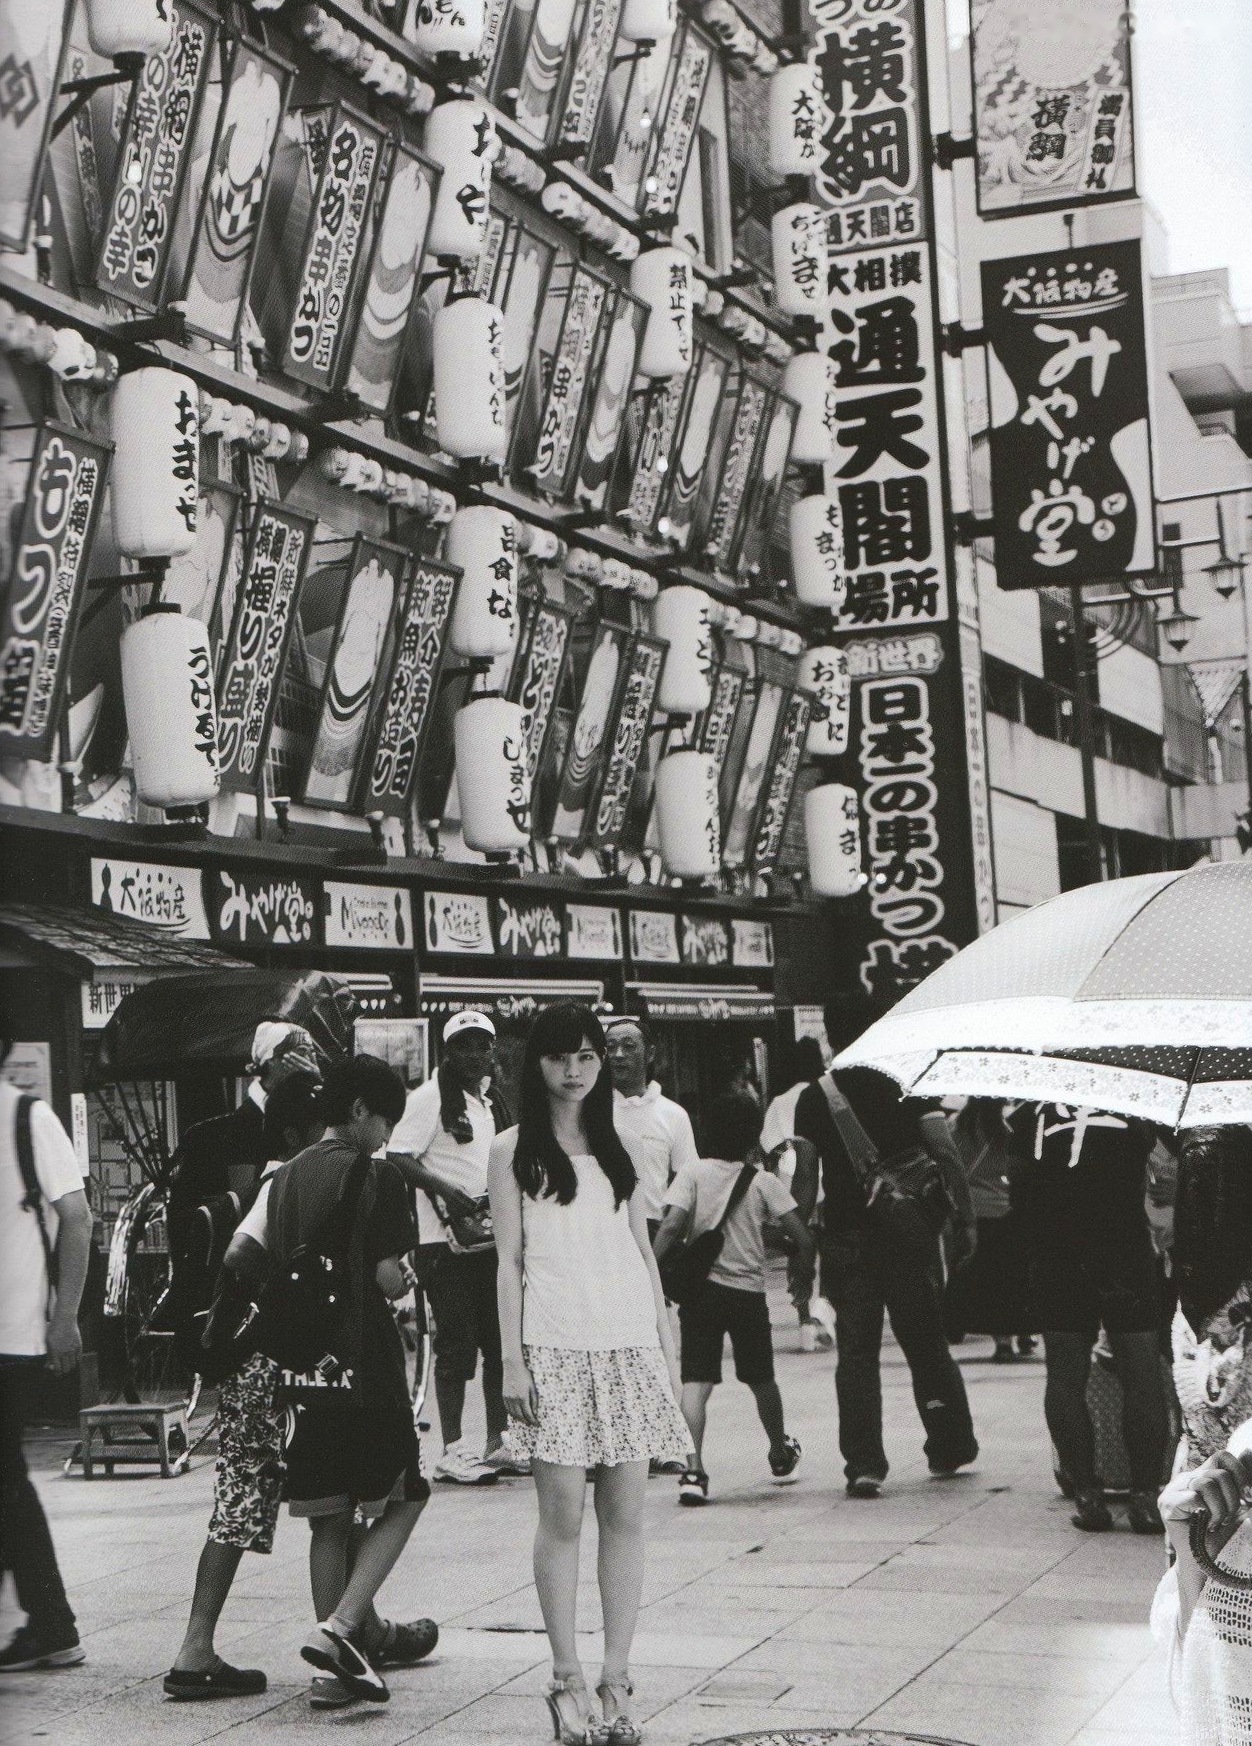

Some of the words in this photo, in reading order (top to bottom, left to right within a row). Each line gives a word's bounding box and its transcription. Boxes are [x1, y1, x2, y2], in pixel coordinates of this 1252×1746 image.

[813, 20, 911, 201] 横綱
[1026, 95, 1070, 161] 横綱
[103, 46, 170, 282] の幸山の幸
[827, 250, 922, 296] 大相撲
[828, 294, 932, 571] 通天閣
[1019, 322, 1123, 567] みやげ堂
[839, 566, 939, 624] 場所
[846, 632, 944, 680] 新世界
[120, 876, 187, 922] 大阪物産
[219, 868, 306, 943] みやげ堂
